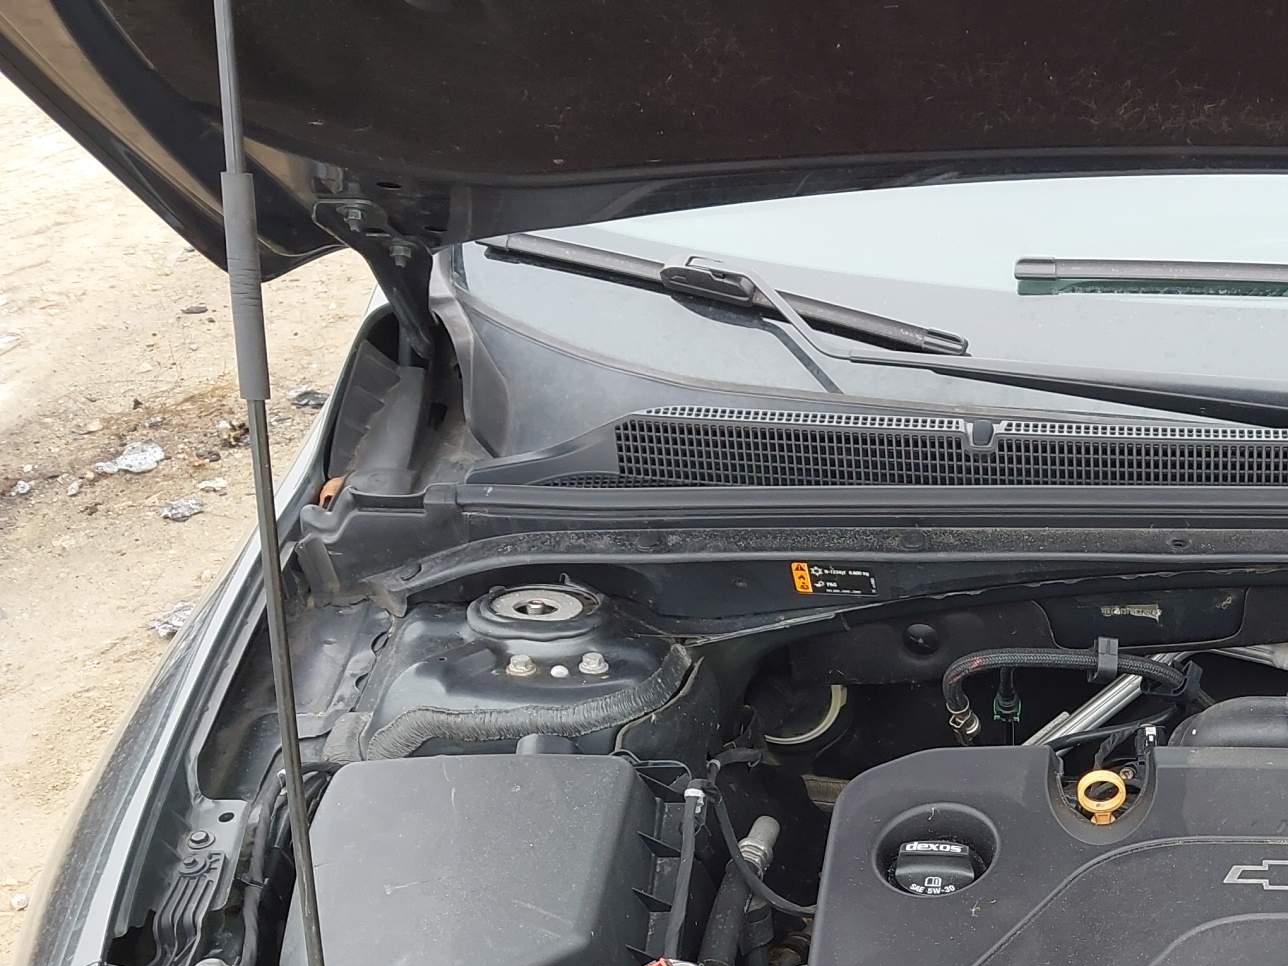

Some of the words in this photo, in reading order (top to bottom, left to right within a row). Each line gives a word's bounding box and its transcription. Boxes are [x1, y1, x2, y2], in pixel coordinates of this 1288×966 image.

[905, 842, 962, 853] dexos
[910, 884, 926, 893] SAE
[927, 884, 956, 894] 5W-30
